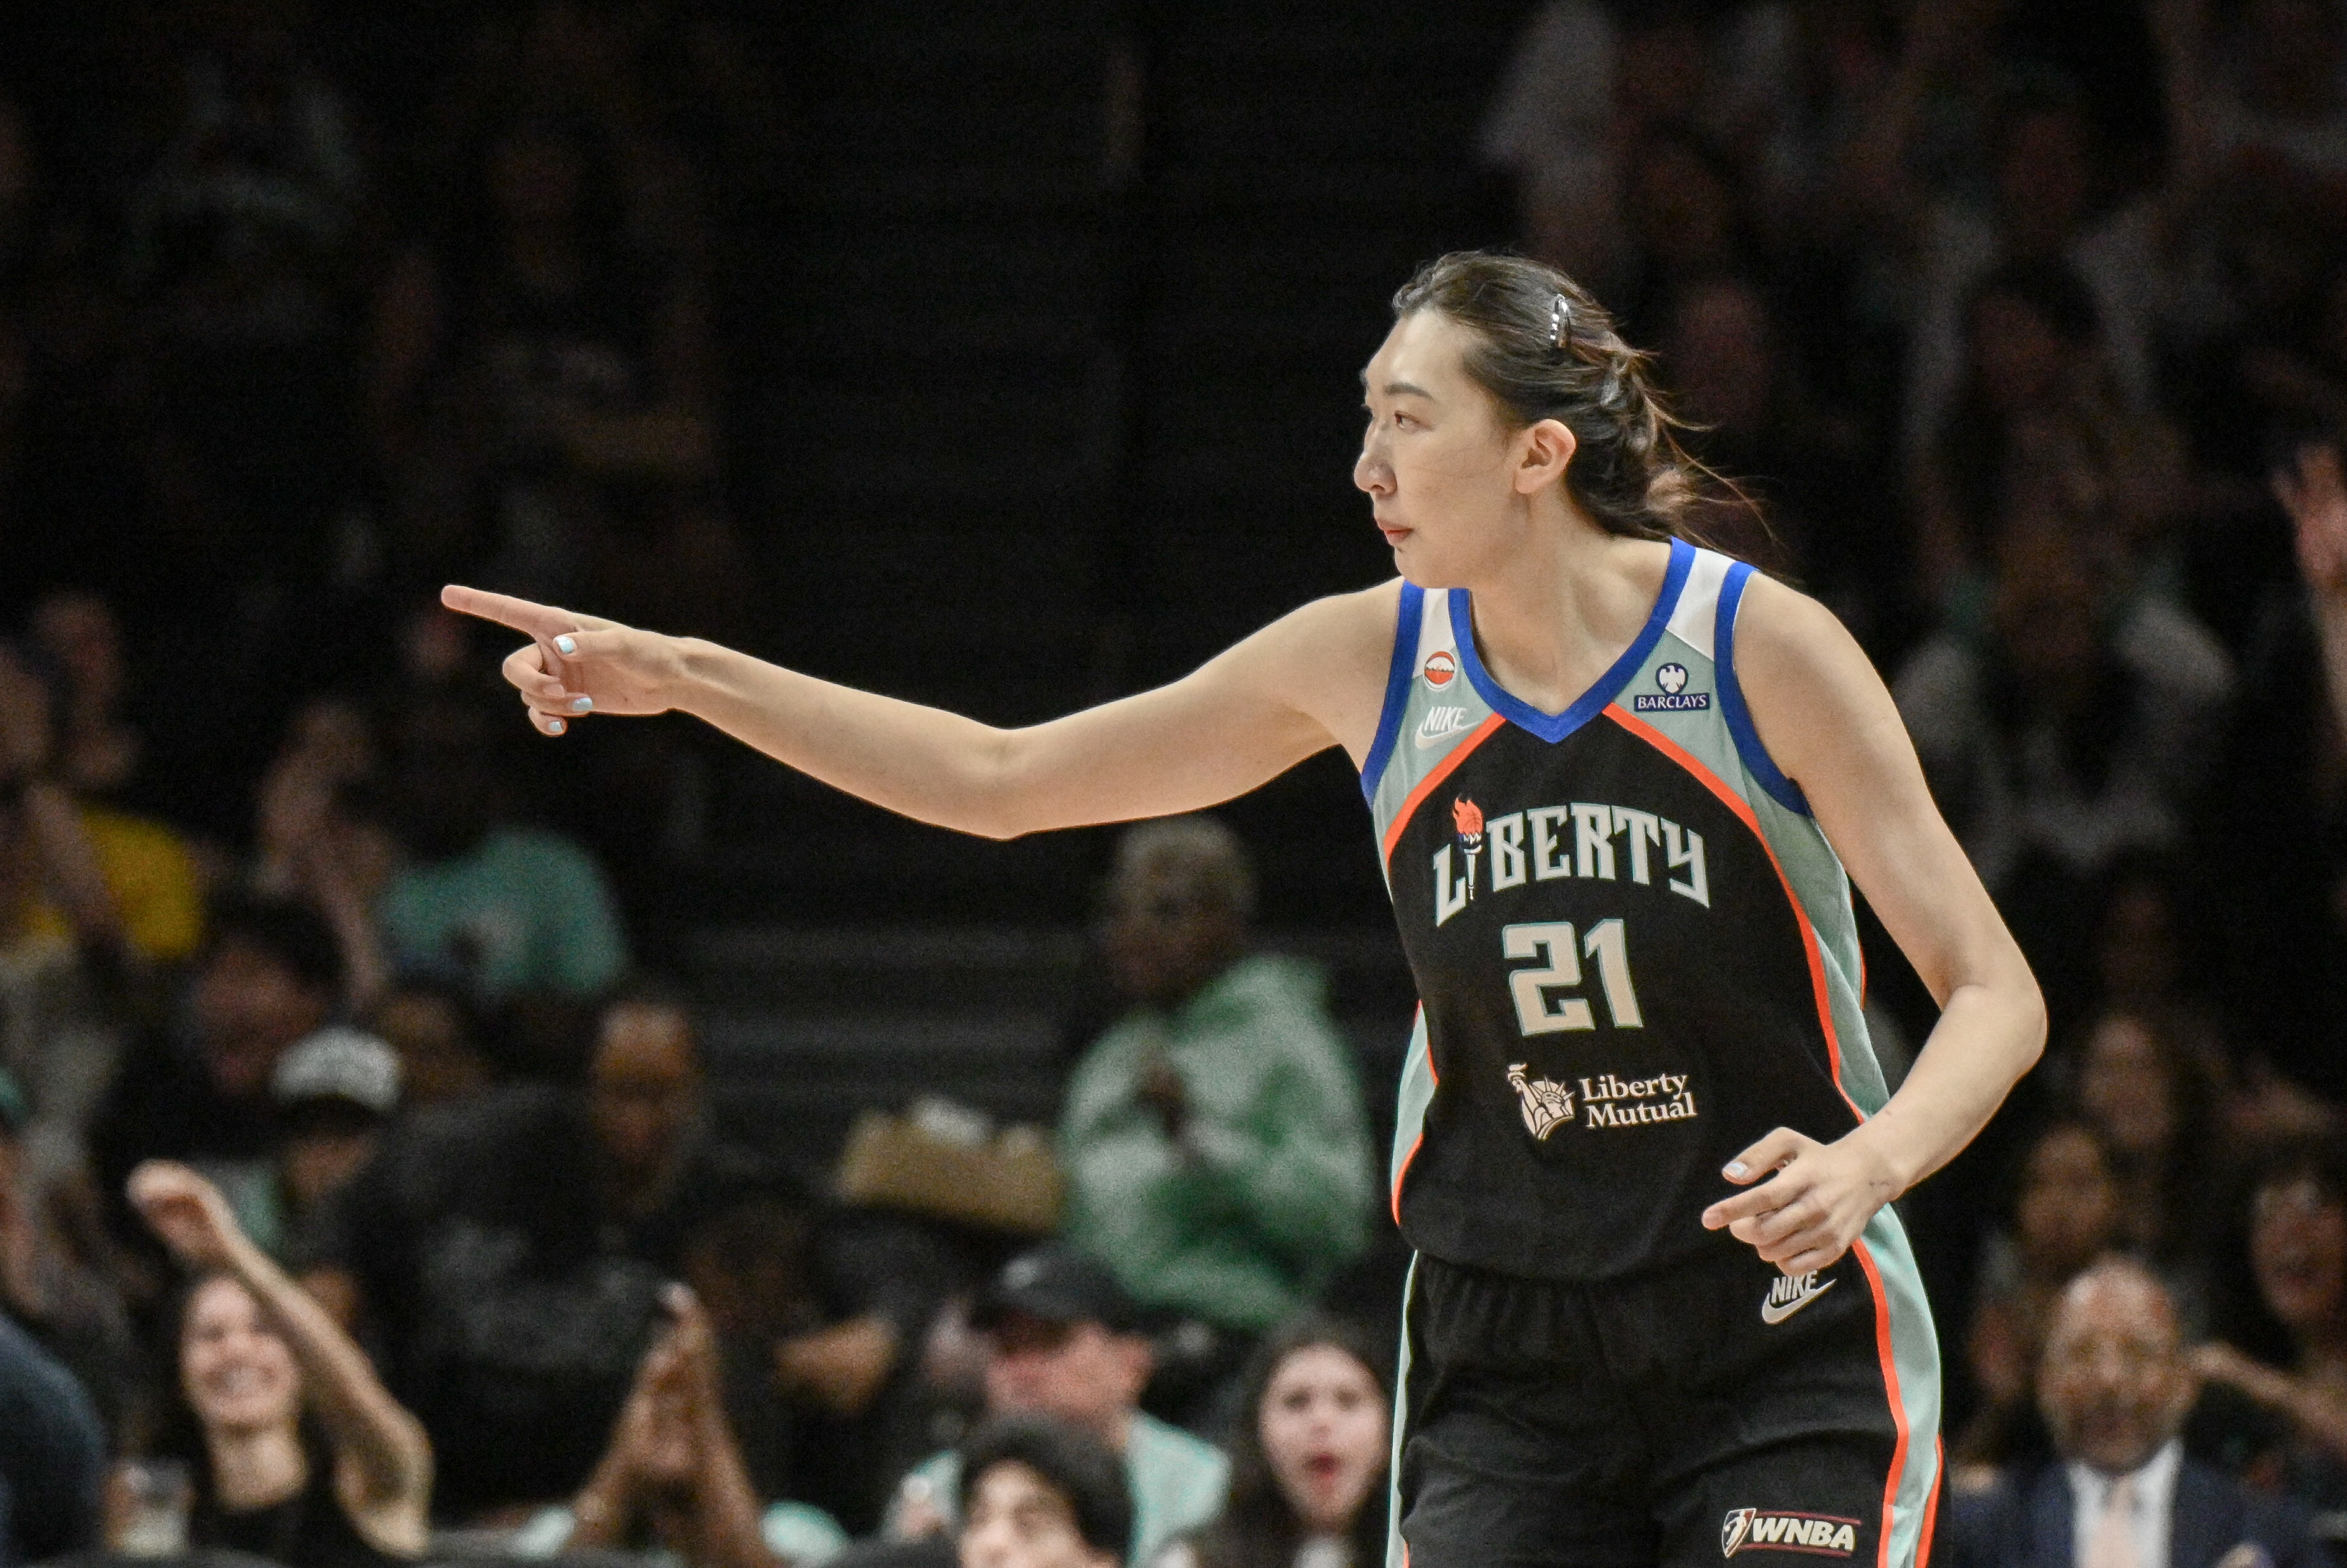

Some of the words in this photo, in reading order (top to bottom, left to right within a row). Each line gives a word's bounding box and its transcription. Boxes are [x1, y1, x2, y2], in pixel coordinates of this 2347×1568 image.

[1638, 694, 1707, 709] BARCLAYS
[1424, 706, 1468, 732] NIKE
[1433, 797, 1710, 927] LIBERTY
[1502, 919, 1644, 1037] 21
[1579, 1073, 1688, 1101] Liberty
[1586, 1091, 1698, 1129] Mutual
[1771, 1270, 1818, 1304] NIKE
[1753, 1517, 1856, 1552] WNBA
